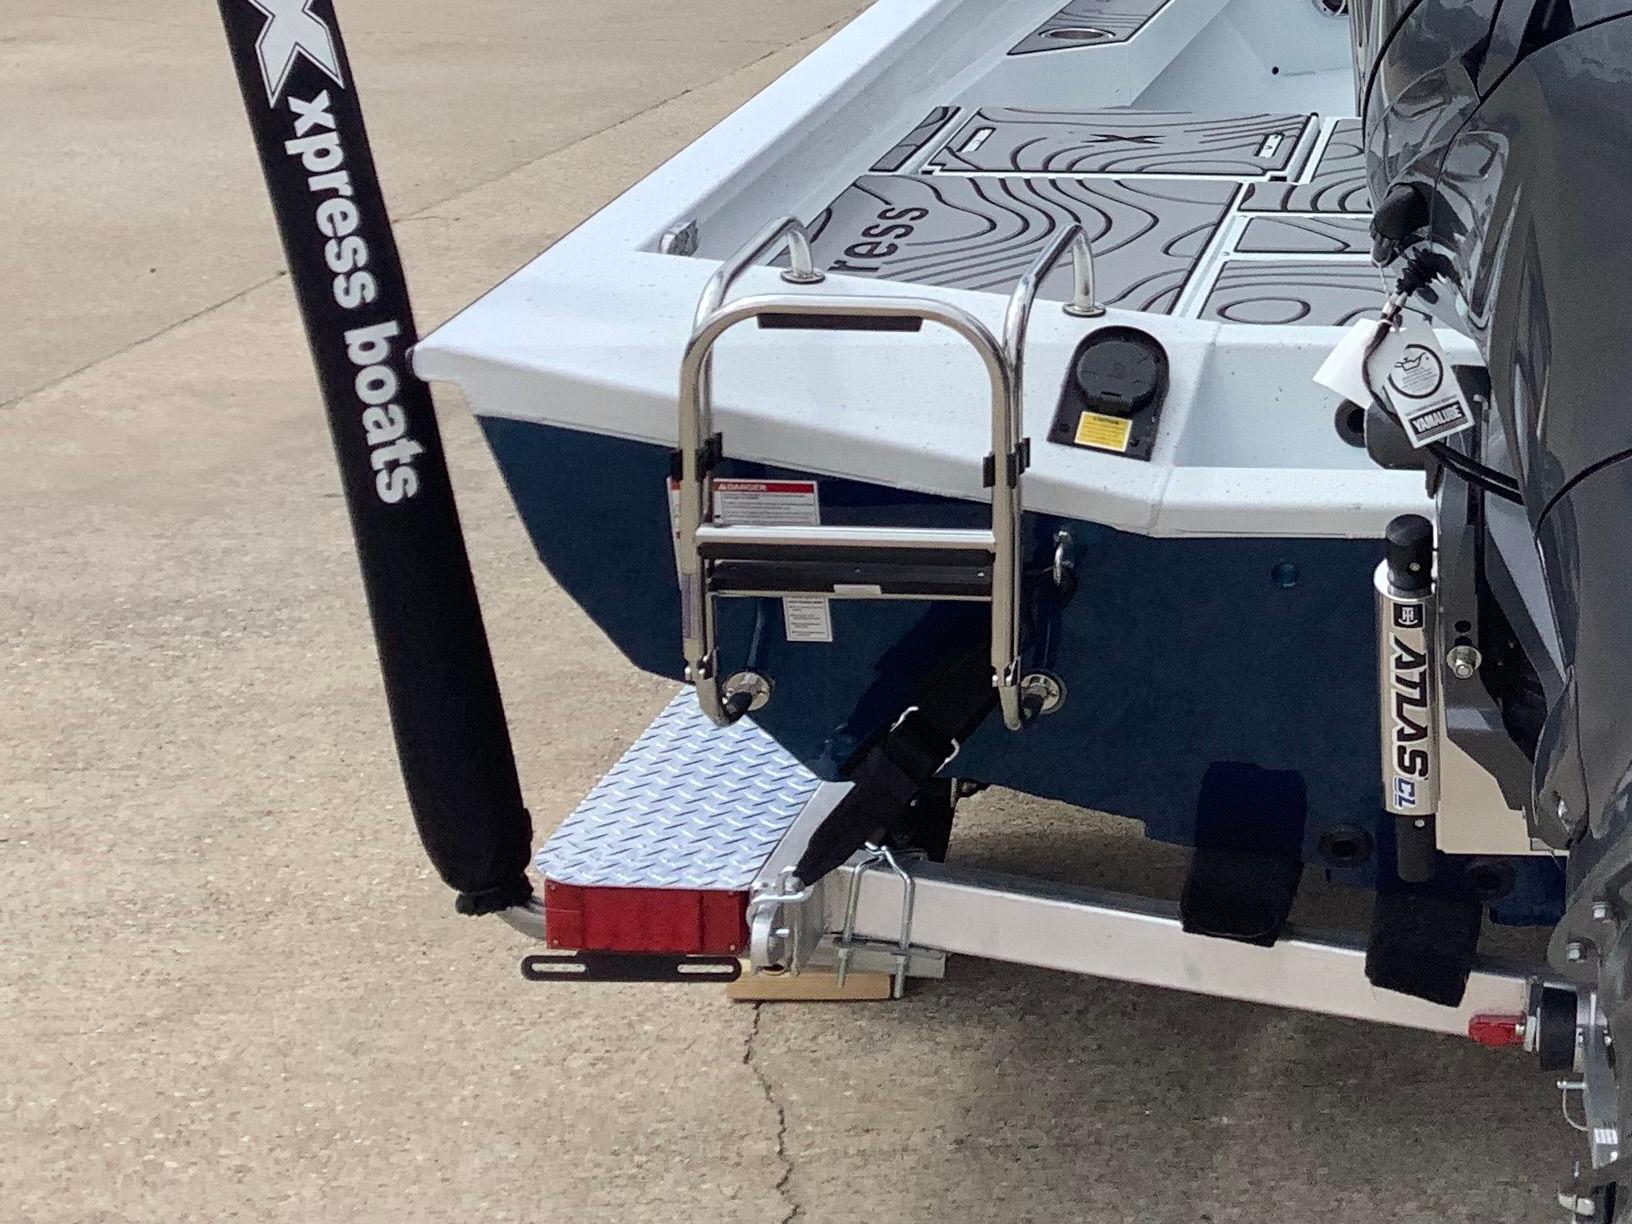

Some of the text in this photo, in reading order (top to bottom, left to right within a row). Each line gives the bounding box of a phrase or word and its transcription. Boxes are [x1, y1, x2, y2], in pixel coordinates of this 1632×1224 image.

[284, 89, 377, 310] xpress
[343, 320, 424, 506] boats
[1391, 634, 1430, 809] ATLAS CL
